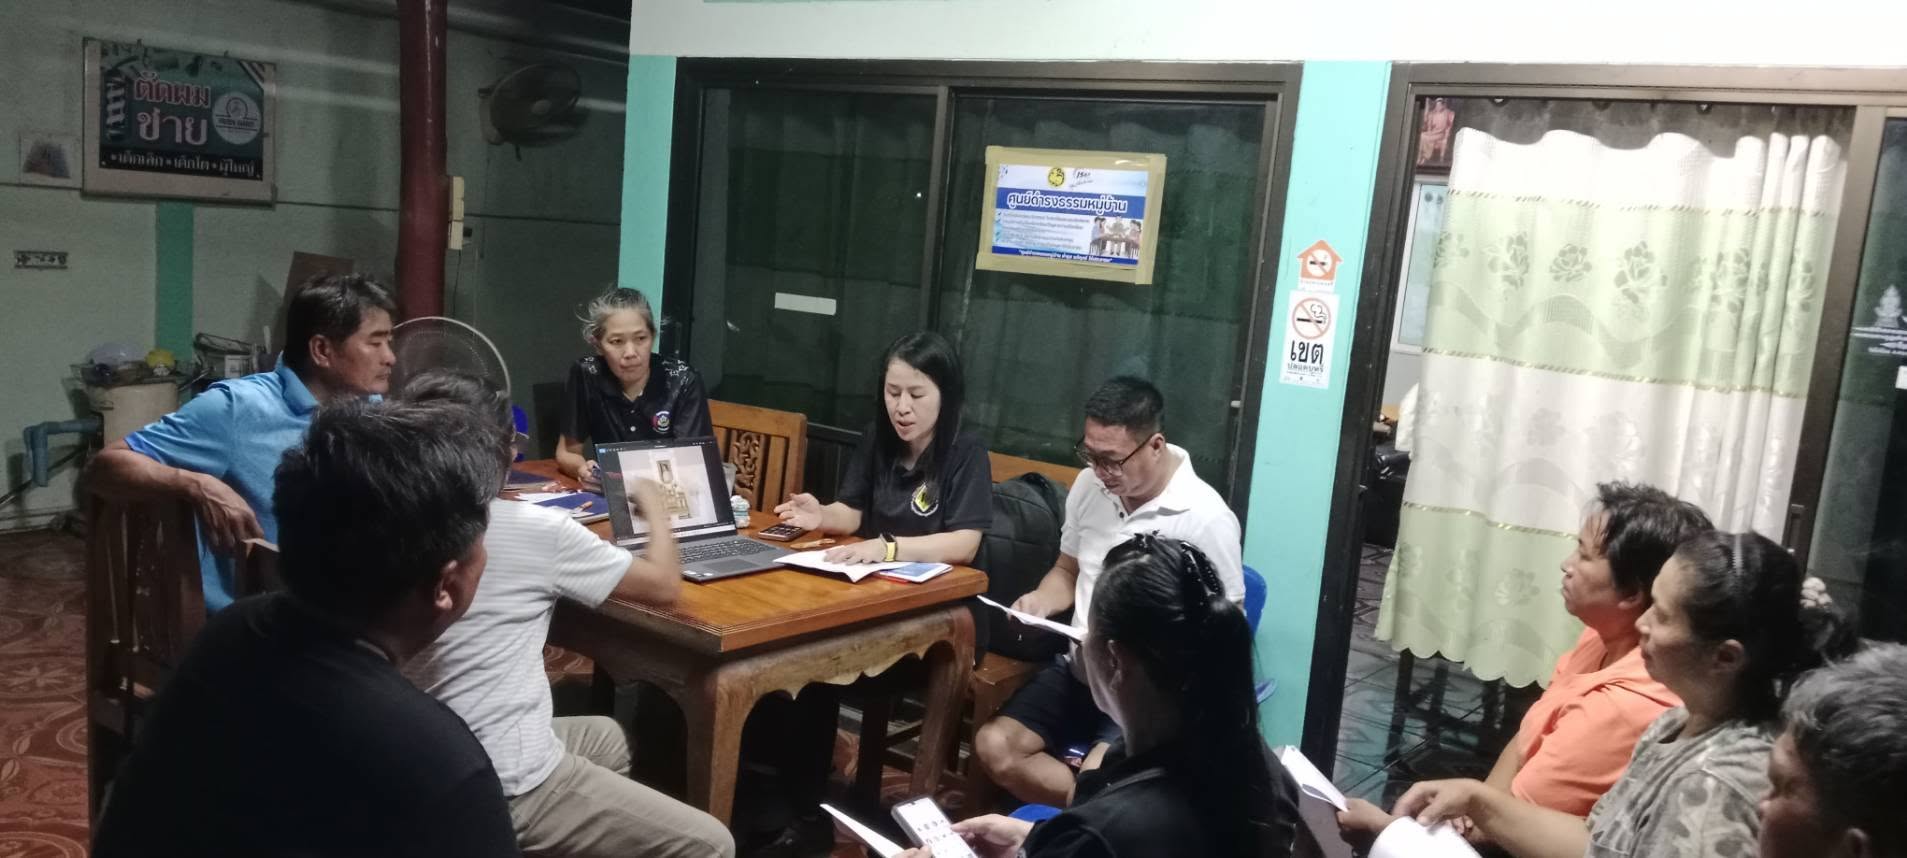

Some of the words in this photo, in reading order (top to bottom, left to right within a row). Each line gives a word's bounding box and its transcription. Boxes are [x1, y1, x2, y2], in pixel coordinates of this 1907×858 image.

[134, 71, 211, 107] ตัดผม
[137, 108, 207, 145] ชาย
[1007, 191, 1127, 214] ศูนย์ดำรงธรรมหมู่บ้าน
[1290, 340, 1323, 364] เขต
